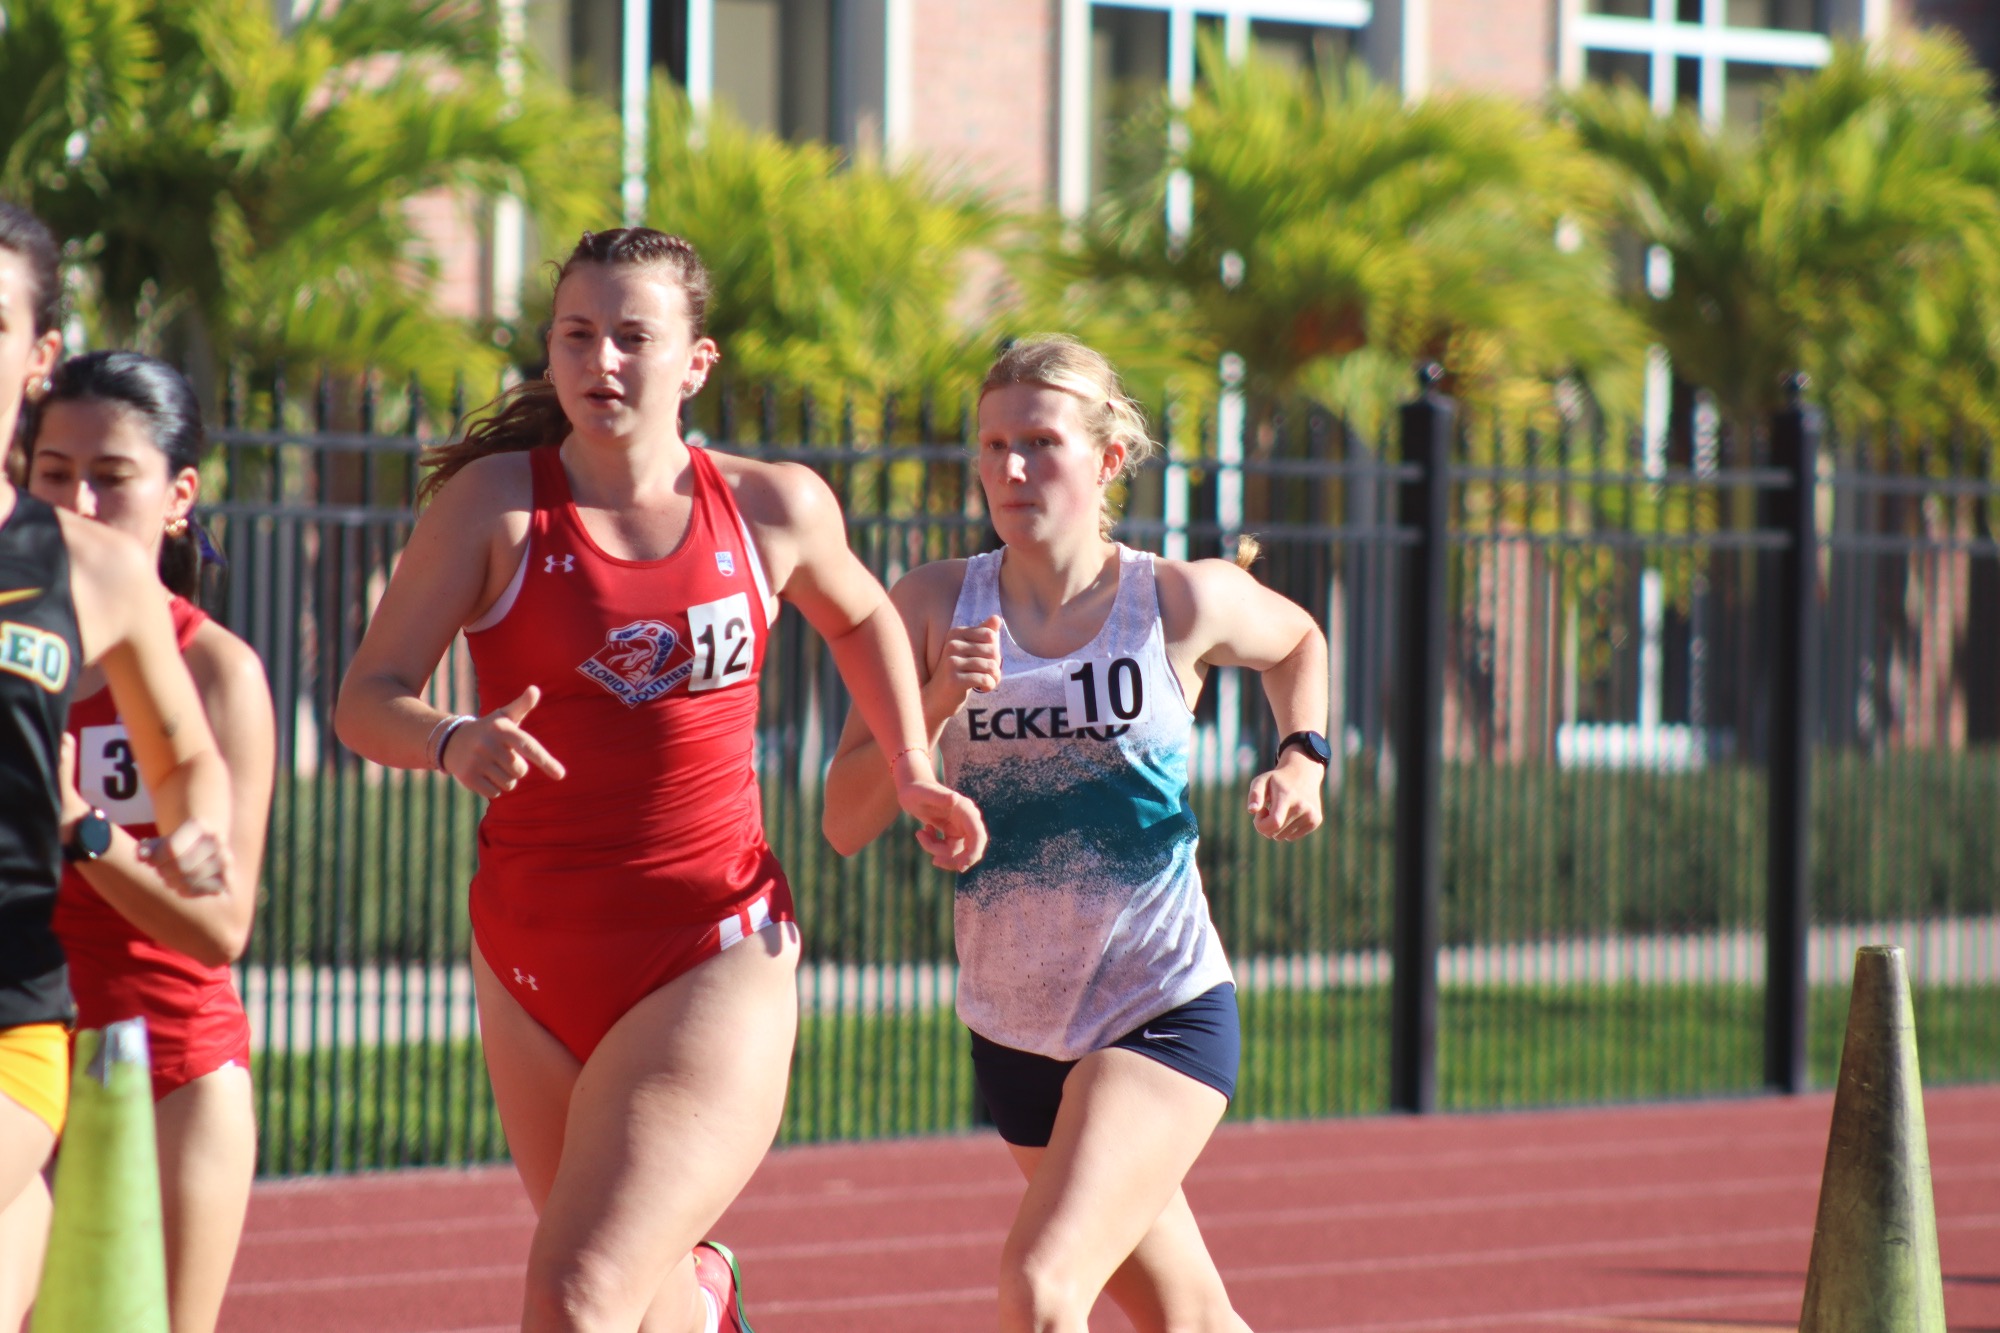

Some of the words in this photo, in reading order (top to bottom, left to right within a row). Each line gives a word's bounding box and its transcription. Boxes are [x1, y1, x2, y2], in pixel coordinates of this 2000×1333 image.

[0, 627, 66, 687] EO
[580, 660, 629, 698] FLORIDA
[697, 617, 748, 680] 12
[1070, 657, 1143, 722] 10
[102, 738, 138, 801] 3
